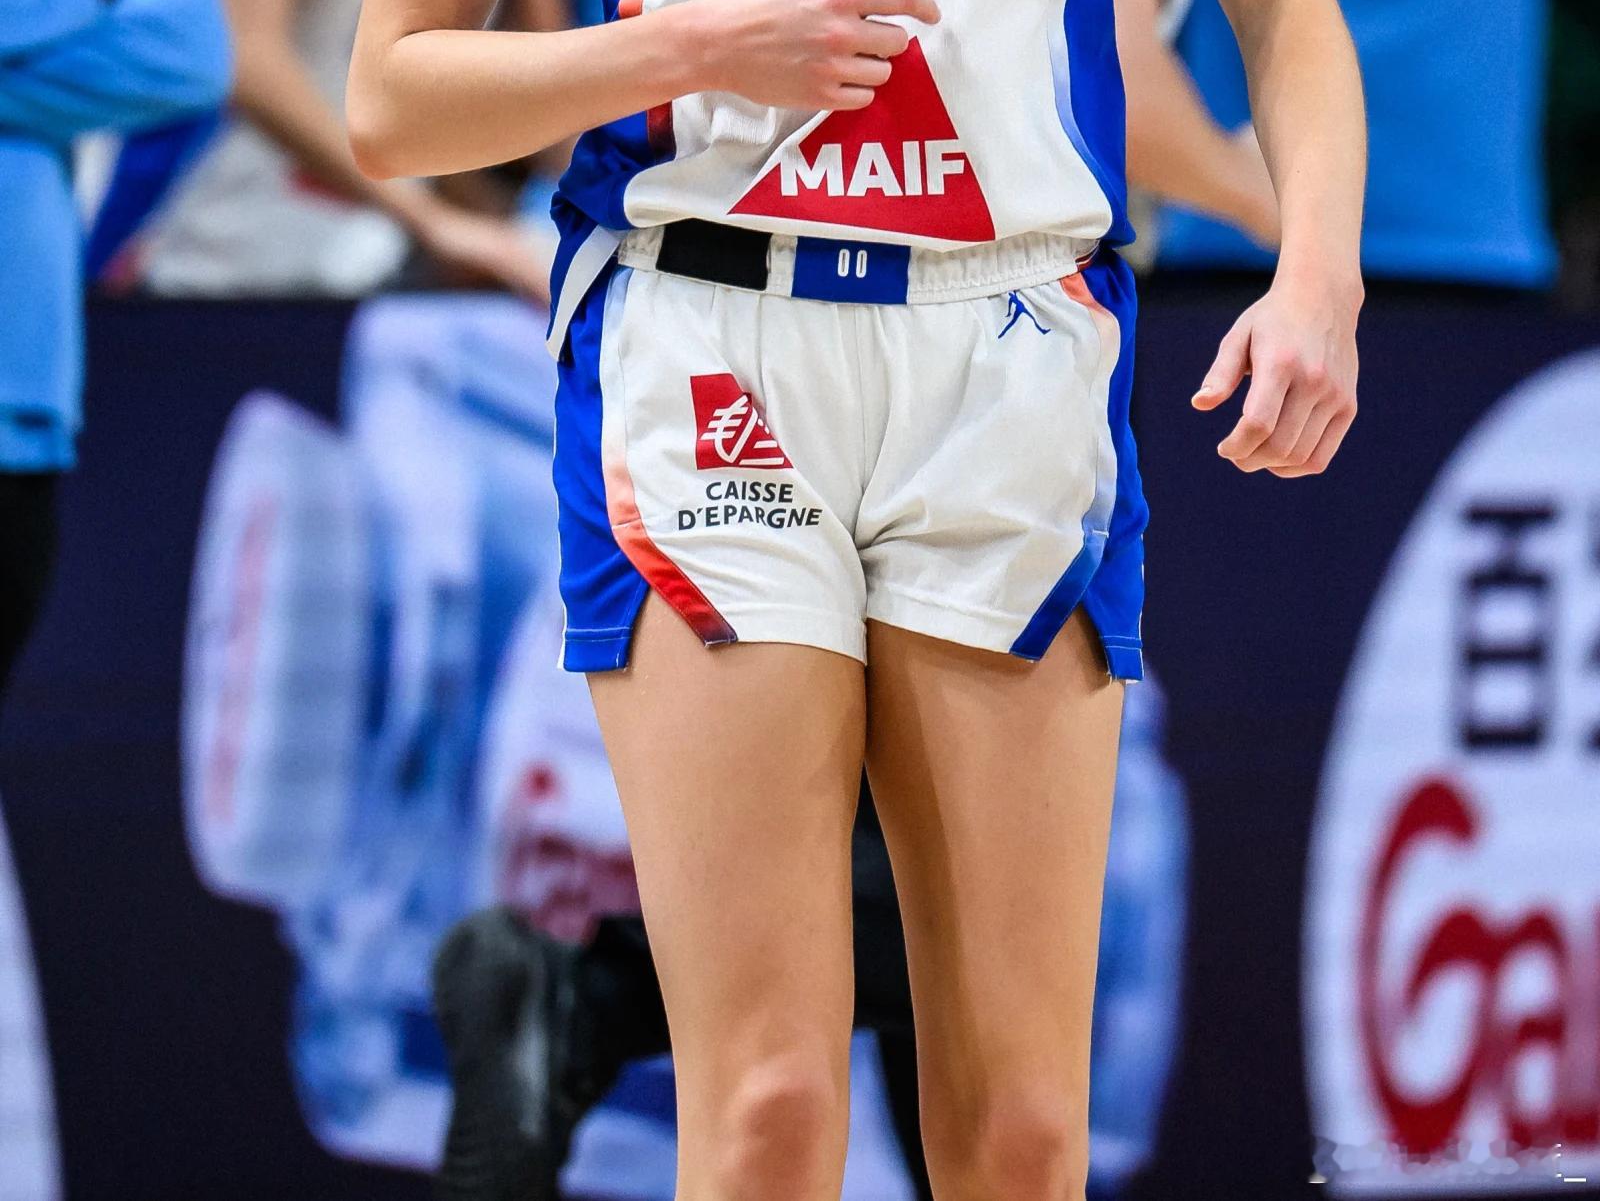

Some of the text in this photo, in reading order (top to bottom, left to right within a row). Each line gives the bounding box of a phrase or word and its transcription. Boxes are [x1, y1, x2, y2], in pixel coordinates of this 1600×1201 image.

[779, 139, 969, 197] MAIF
[705, 480, 794, 504] CAISSE
[677, 504, 823, 531] D'EPARGNE
